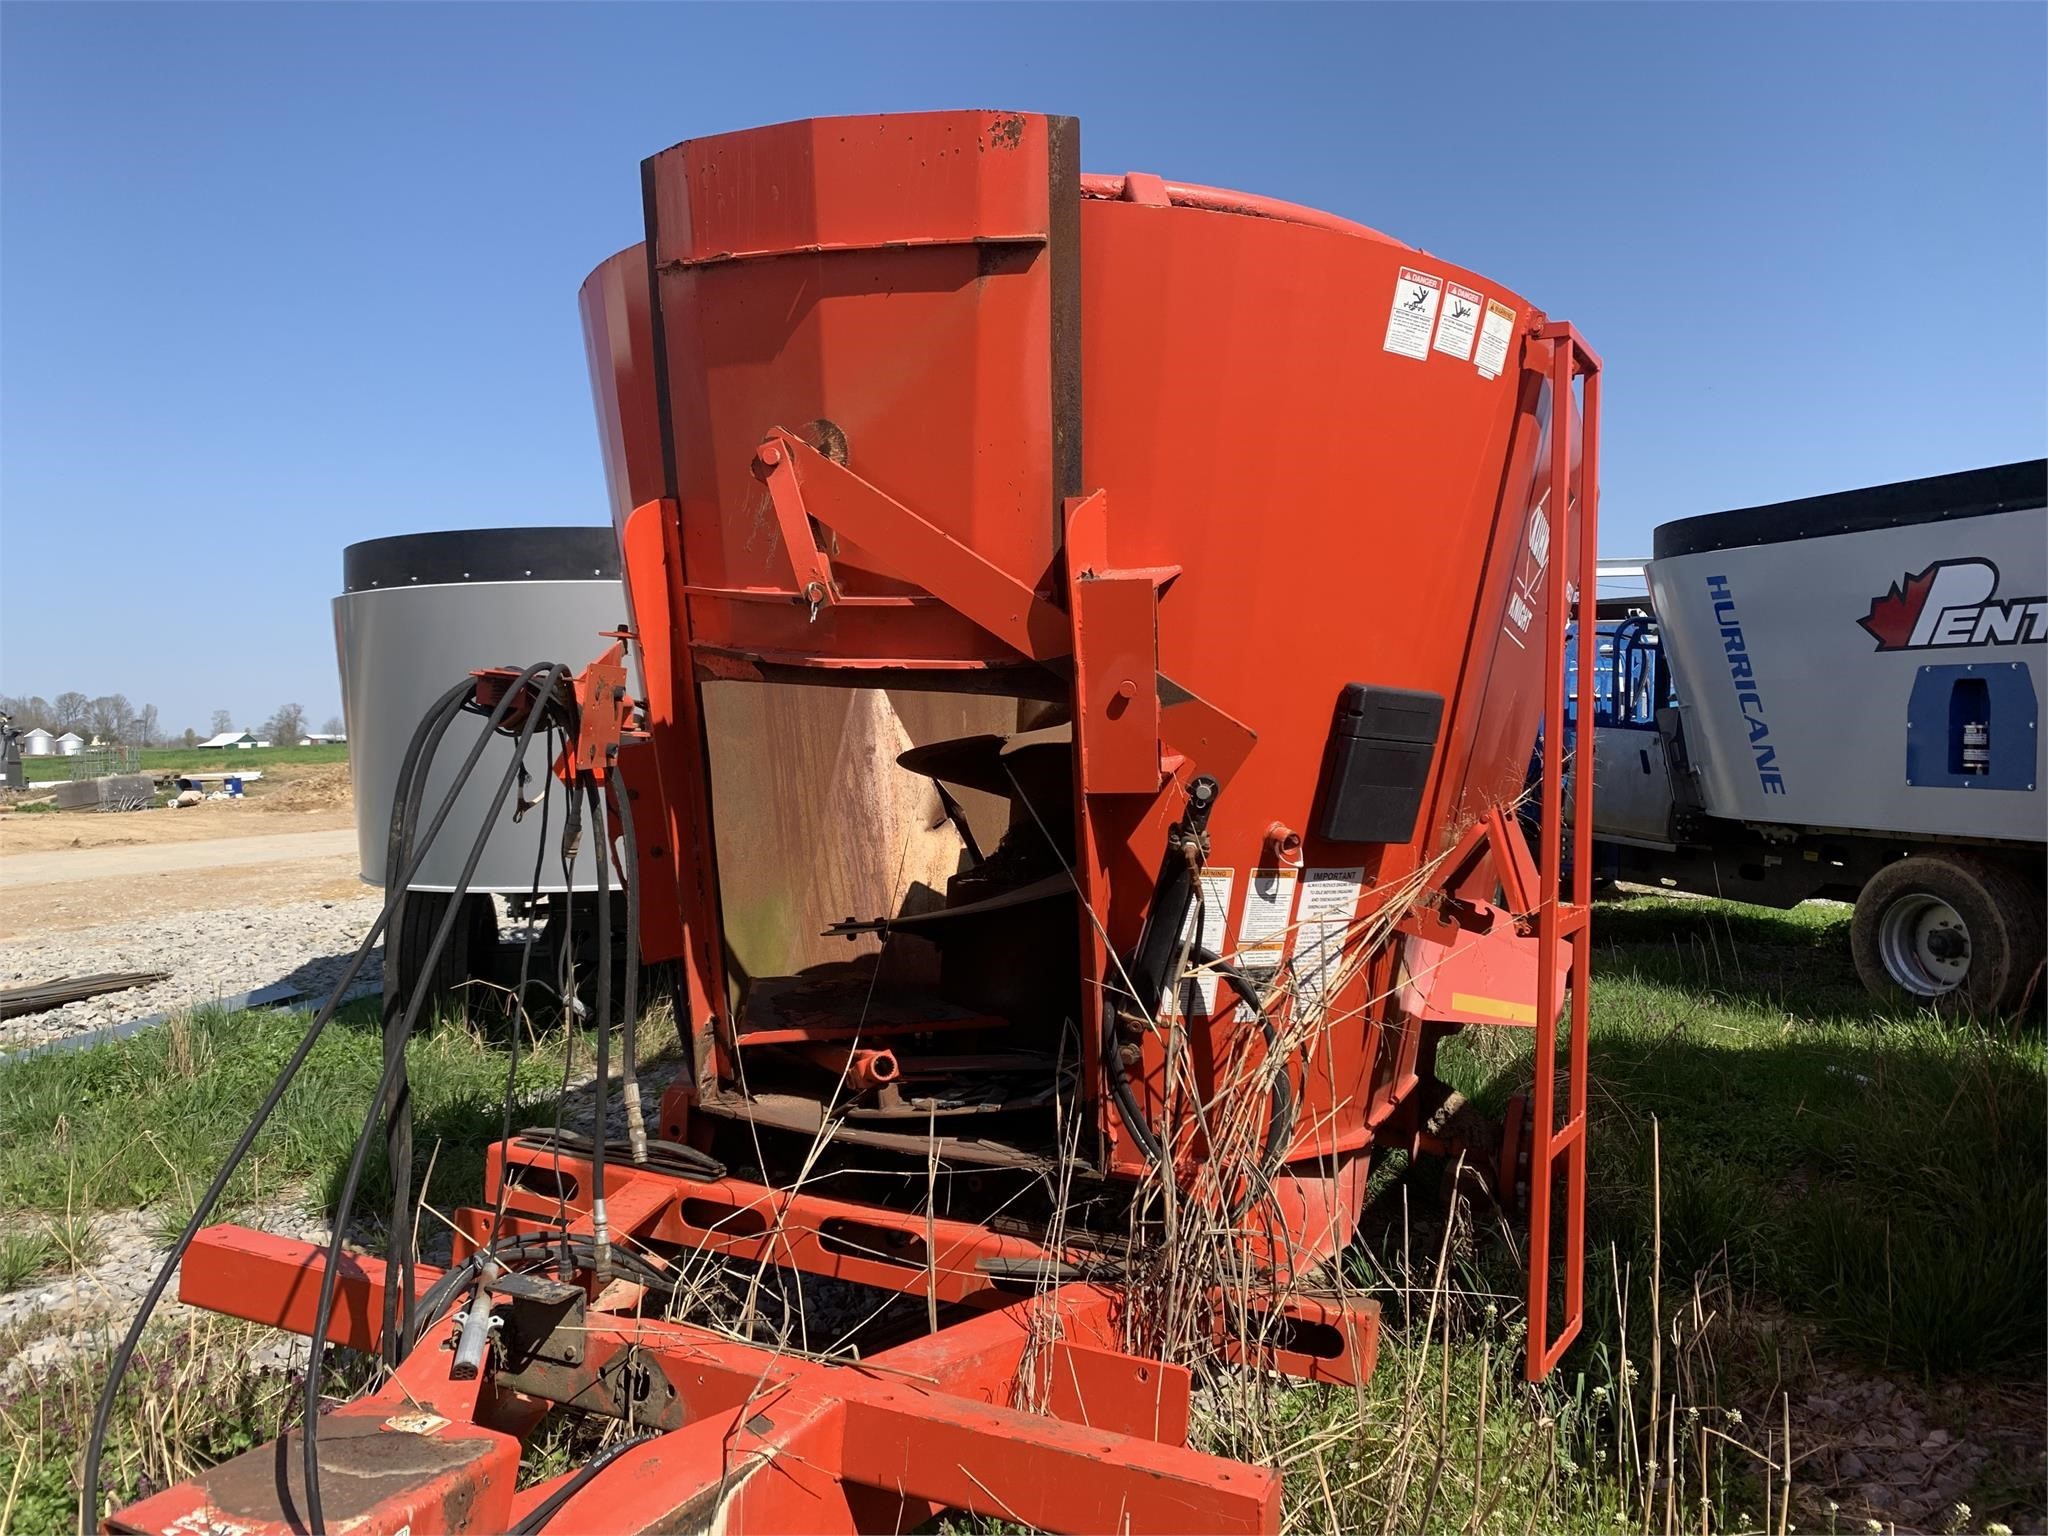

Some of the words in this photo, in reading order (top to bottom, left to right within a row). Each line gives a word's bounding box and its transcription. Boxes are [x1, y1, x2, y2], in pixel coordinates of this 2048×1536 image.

[1411, 273, 1438, 288] DANGER
[1457, 288, 1480, 302] DANGER
[1706, 575, 1786, 796] HURRICANE
[1313, 871, 1357, 881] IMPORTANT
